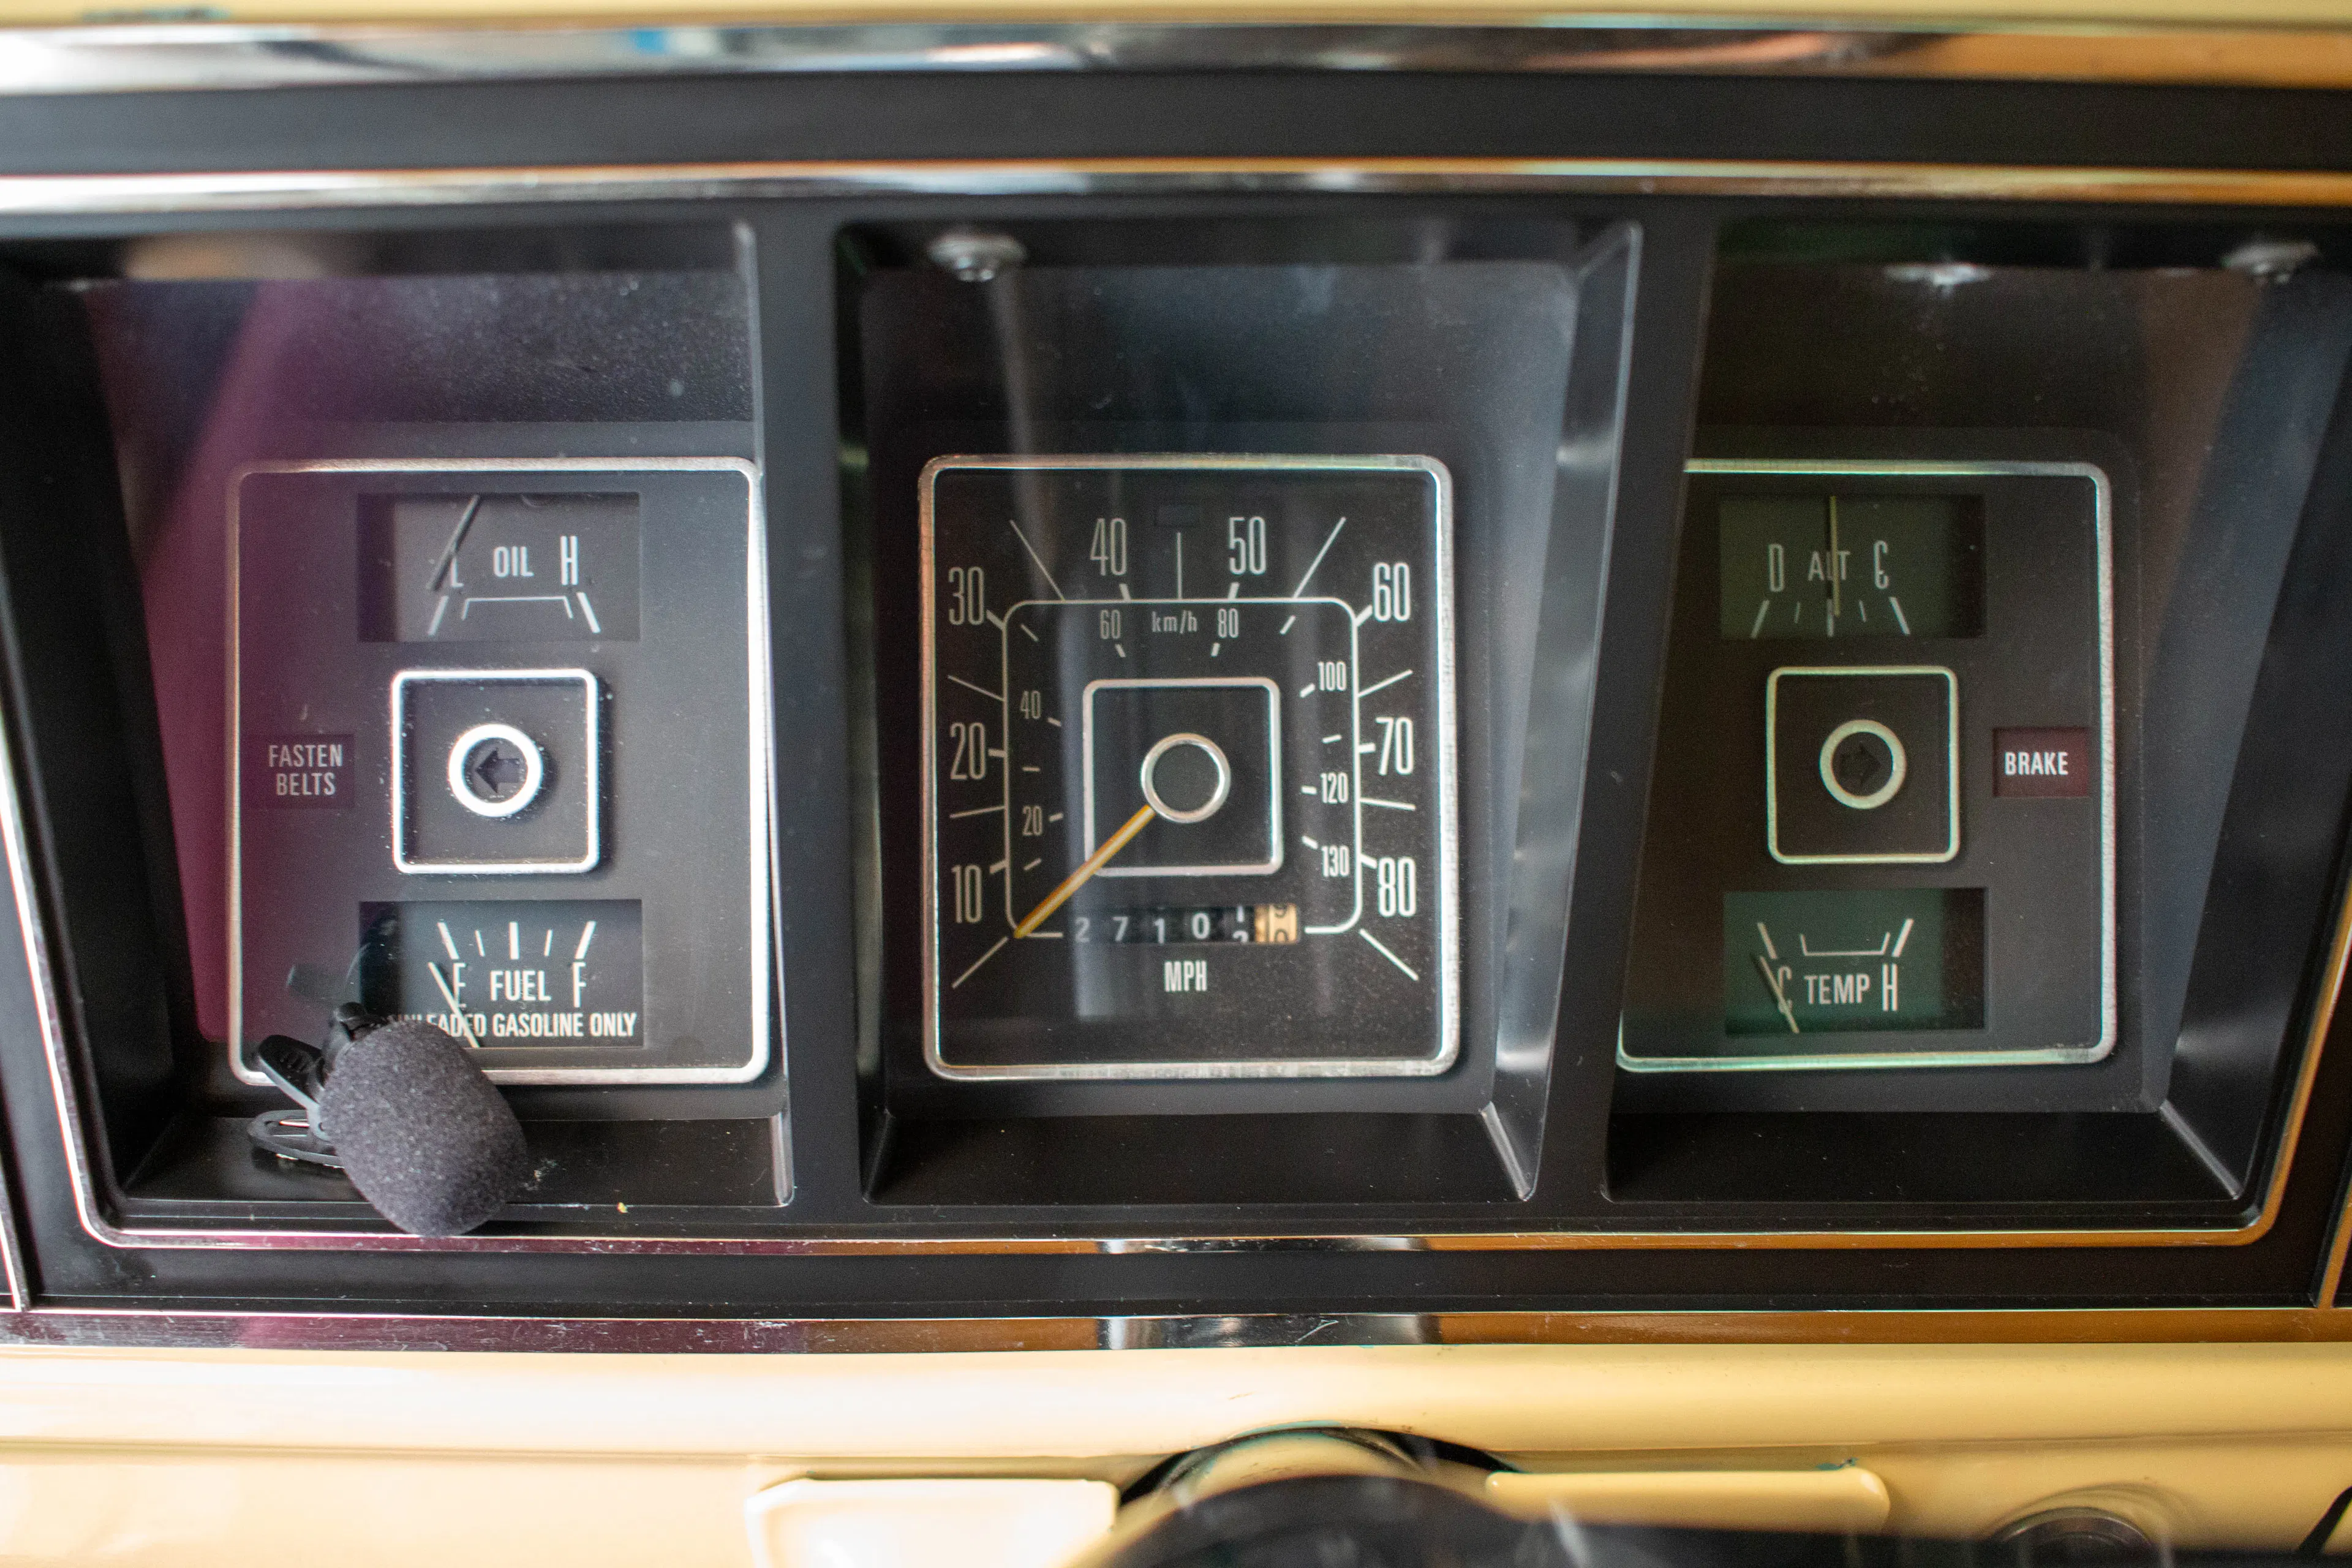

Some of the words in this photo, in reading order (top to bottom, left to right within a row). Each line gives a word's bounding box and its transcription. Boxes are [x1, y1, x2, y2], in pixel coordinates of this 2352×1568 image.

[560, 535, 578, 586] H
[1090, 518, 1128, 576] 40
[1229, 516, 1267, 575] 50
[493, 546, 534, 578] OIL
[948, 566, 985, 626] 30
[1373, 562, 1411, 622] 60
[1099, 609, 1121, 640] 60
[1152, 609, 1198, 635] km/h
[1218, 608, 1239, 638] 80
[1317, 661, 1347, 692] 100
[1020, 690, 1041, 720] 40
[269, 744, 343, 767] FASTEN
[950, 722, 986, 780] 20
[1376, 717, 1414, 776] 70
[2005, 751, 2068, 777] BRAKE
[277, 771, 336, 796] BELTS
[1321, 772, 1349, 804] 120
[1022, 805, 1043, 837] 20
[1321, 845, 1350, 878] 130
[951, 864, 982, 924] 10
[1378, 857, 1417, 917] 80
[490, 970, 552, 1001] FUEL
[572, 961, 587, 1008] F
[1164, 960, 1207, 992] MPH
[1804, 973, 1871, 1005] TEMP
[1882, 963, 1898, 1011] H
[492, 1012, 584, 1037] GASOLINE
[589, 1012, 637, 1037] ONLY
